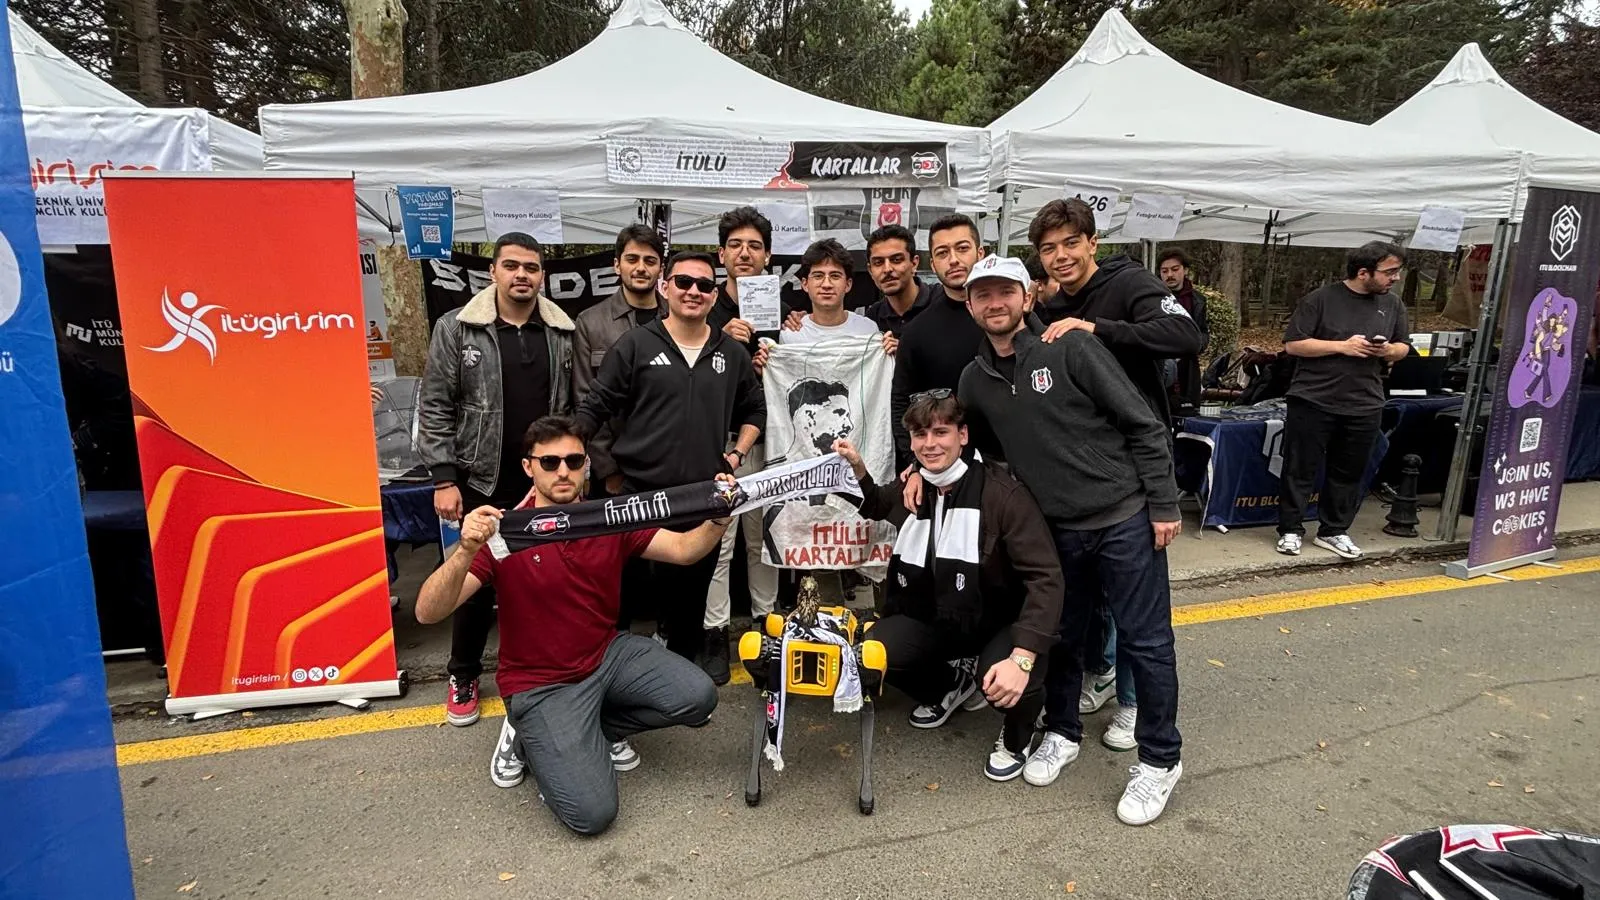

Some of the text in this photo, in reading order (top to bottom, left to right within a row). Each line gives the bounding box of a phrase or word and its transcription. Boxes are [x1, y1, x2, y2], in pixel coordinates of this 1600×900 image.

[676, 151, 727, 172] İTÜLÜ
[811, 156, 901, 177] KARTALLAR
[429, 257, 622, 300] SEDE
[1533, 461, 1552, 479] US,
[1235, 497, 1258, 508] ITU
[1495, 490, 1516, 510] W3
[812, 521, 872, 545] İTÜLÜ
[231, 673, 281, 686] itugirisim
